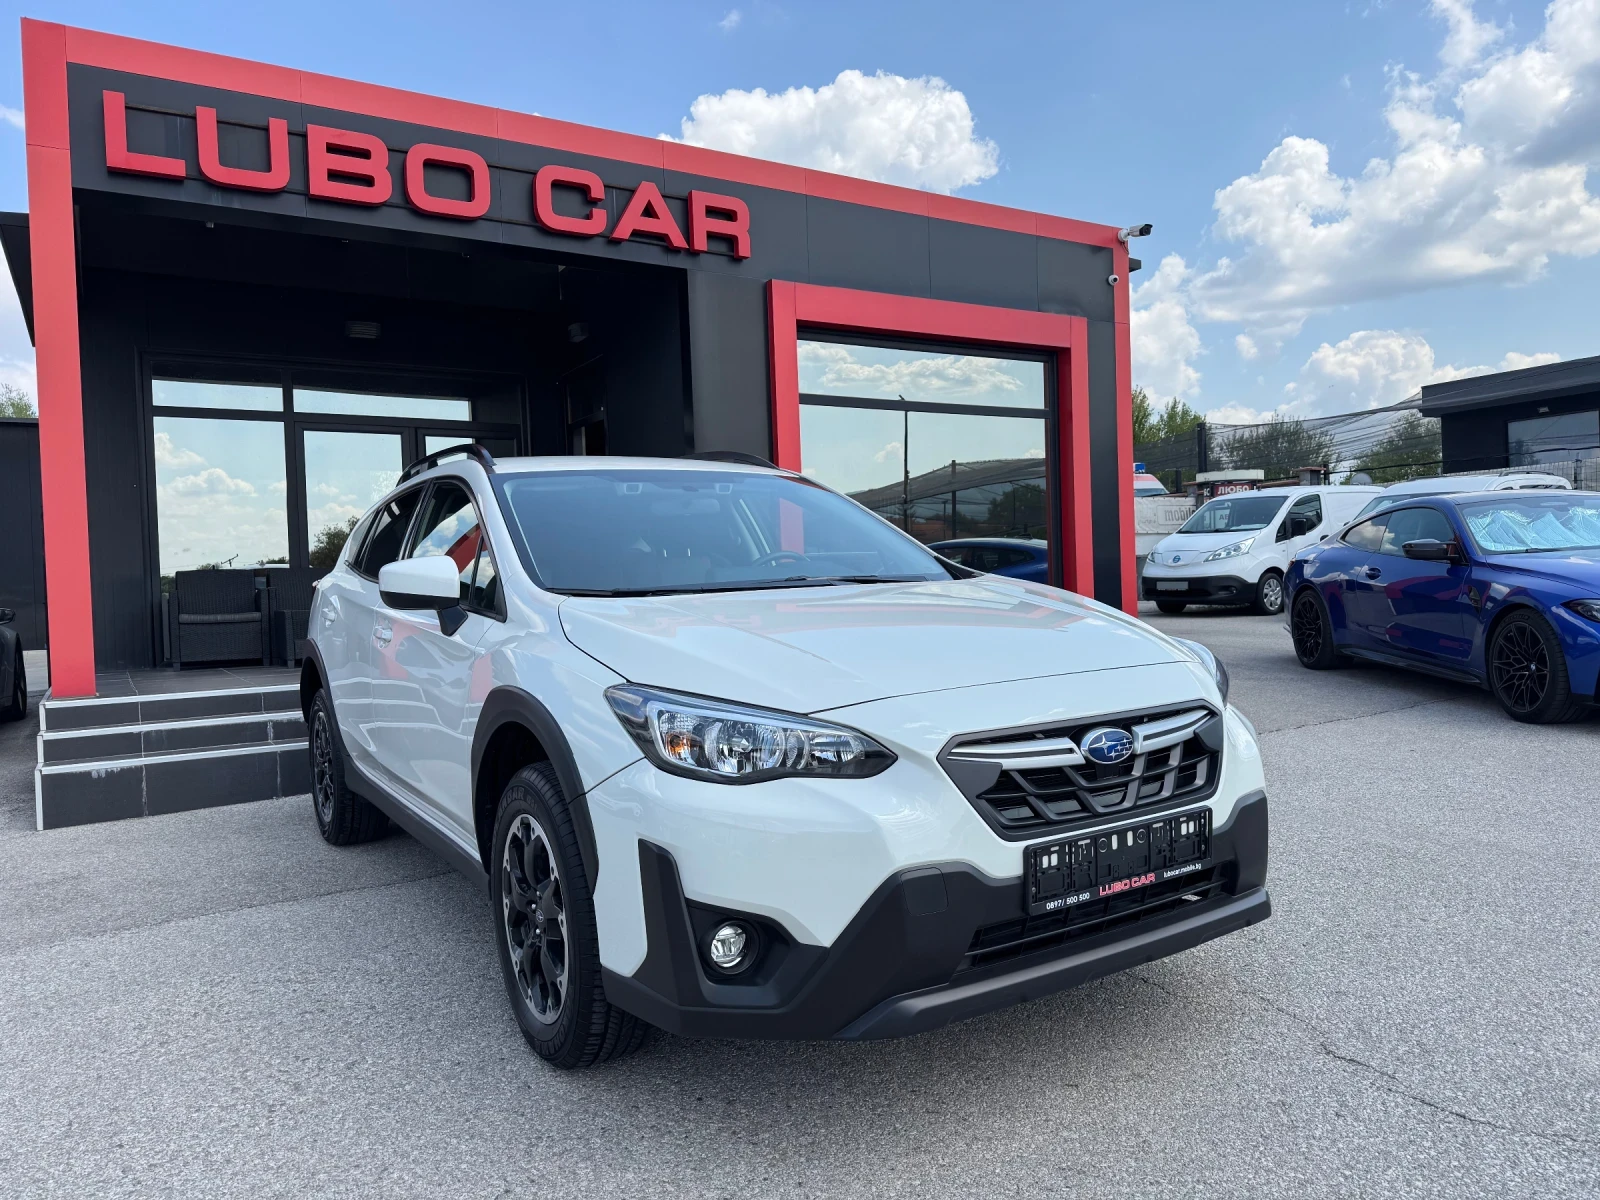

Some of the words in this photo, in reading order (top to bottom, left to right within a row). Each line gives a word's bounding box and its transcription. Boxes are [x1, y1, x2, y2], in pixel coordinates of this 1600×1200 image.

[102, 89, 491, 220] LUBO
[533, 164, 752, 260] CAR
[1217, 485, 1250, 495] ЛЮБО
[1164, 863, 1201, 878] lubocar.mobile.bg
[1100, 880, 1130, 895] LUBO
[1132, 873, 1155, 887] CAR
[1046, 899, 1065, 910] 0897/
[1066, 895, 1078, 905] 500
[1079, 892, 1090, 901] 500
